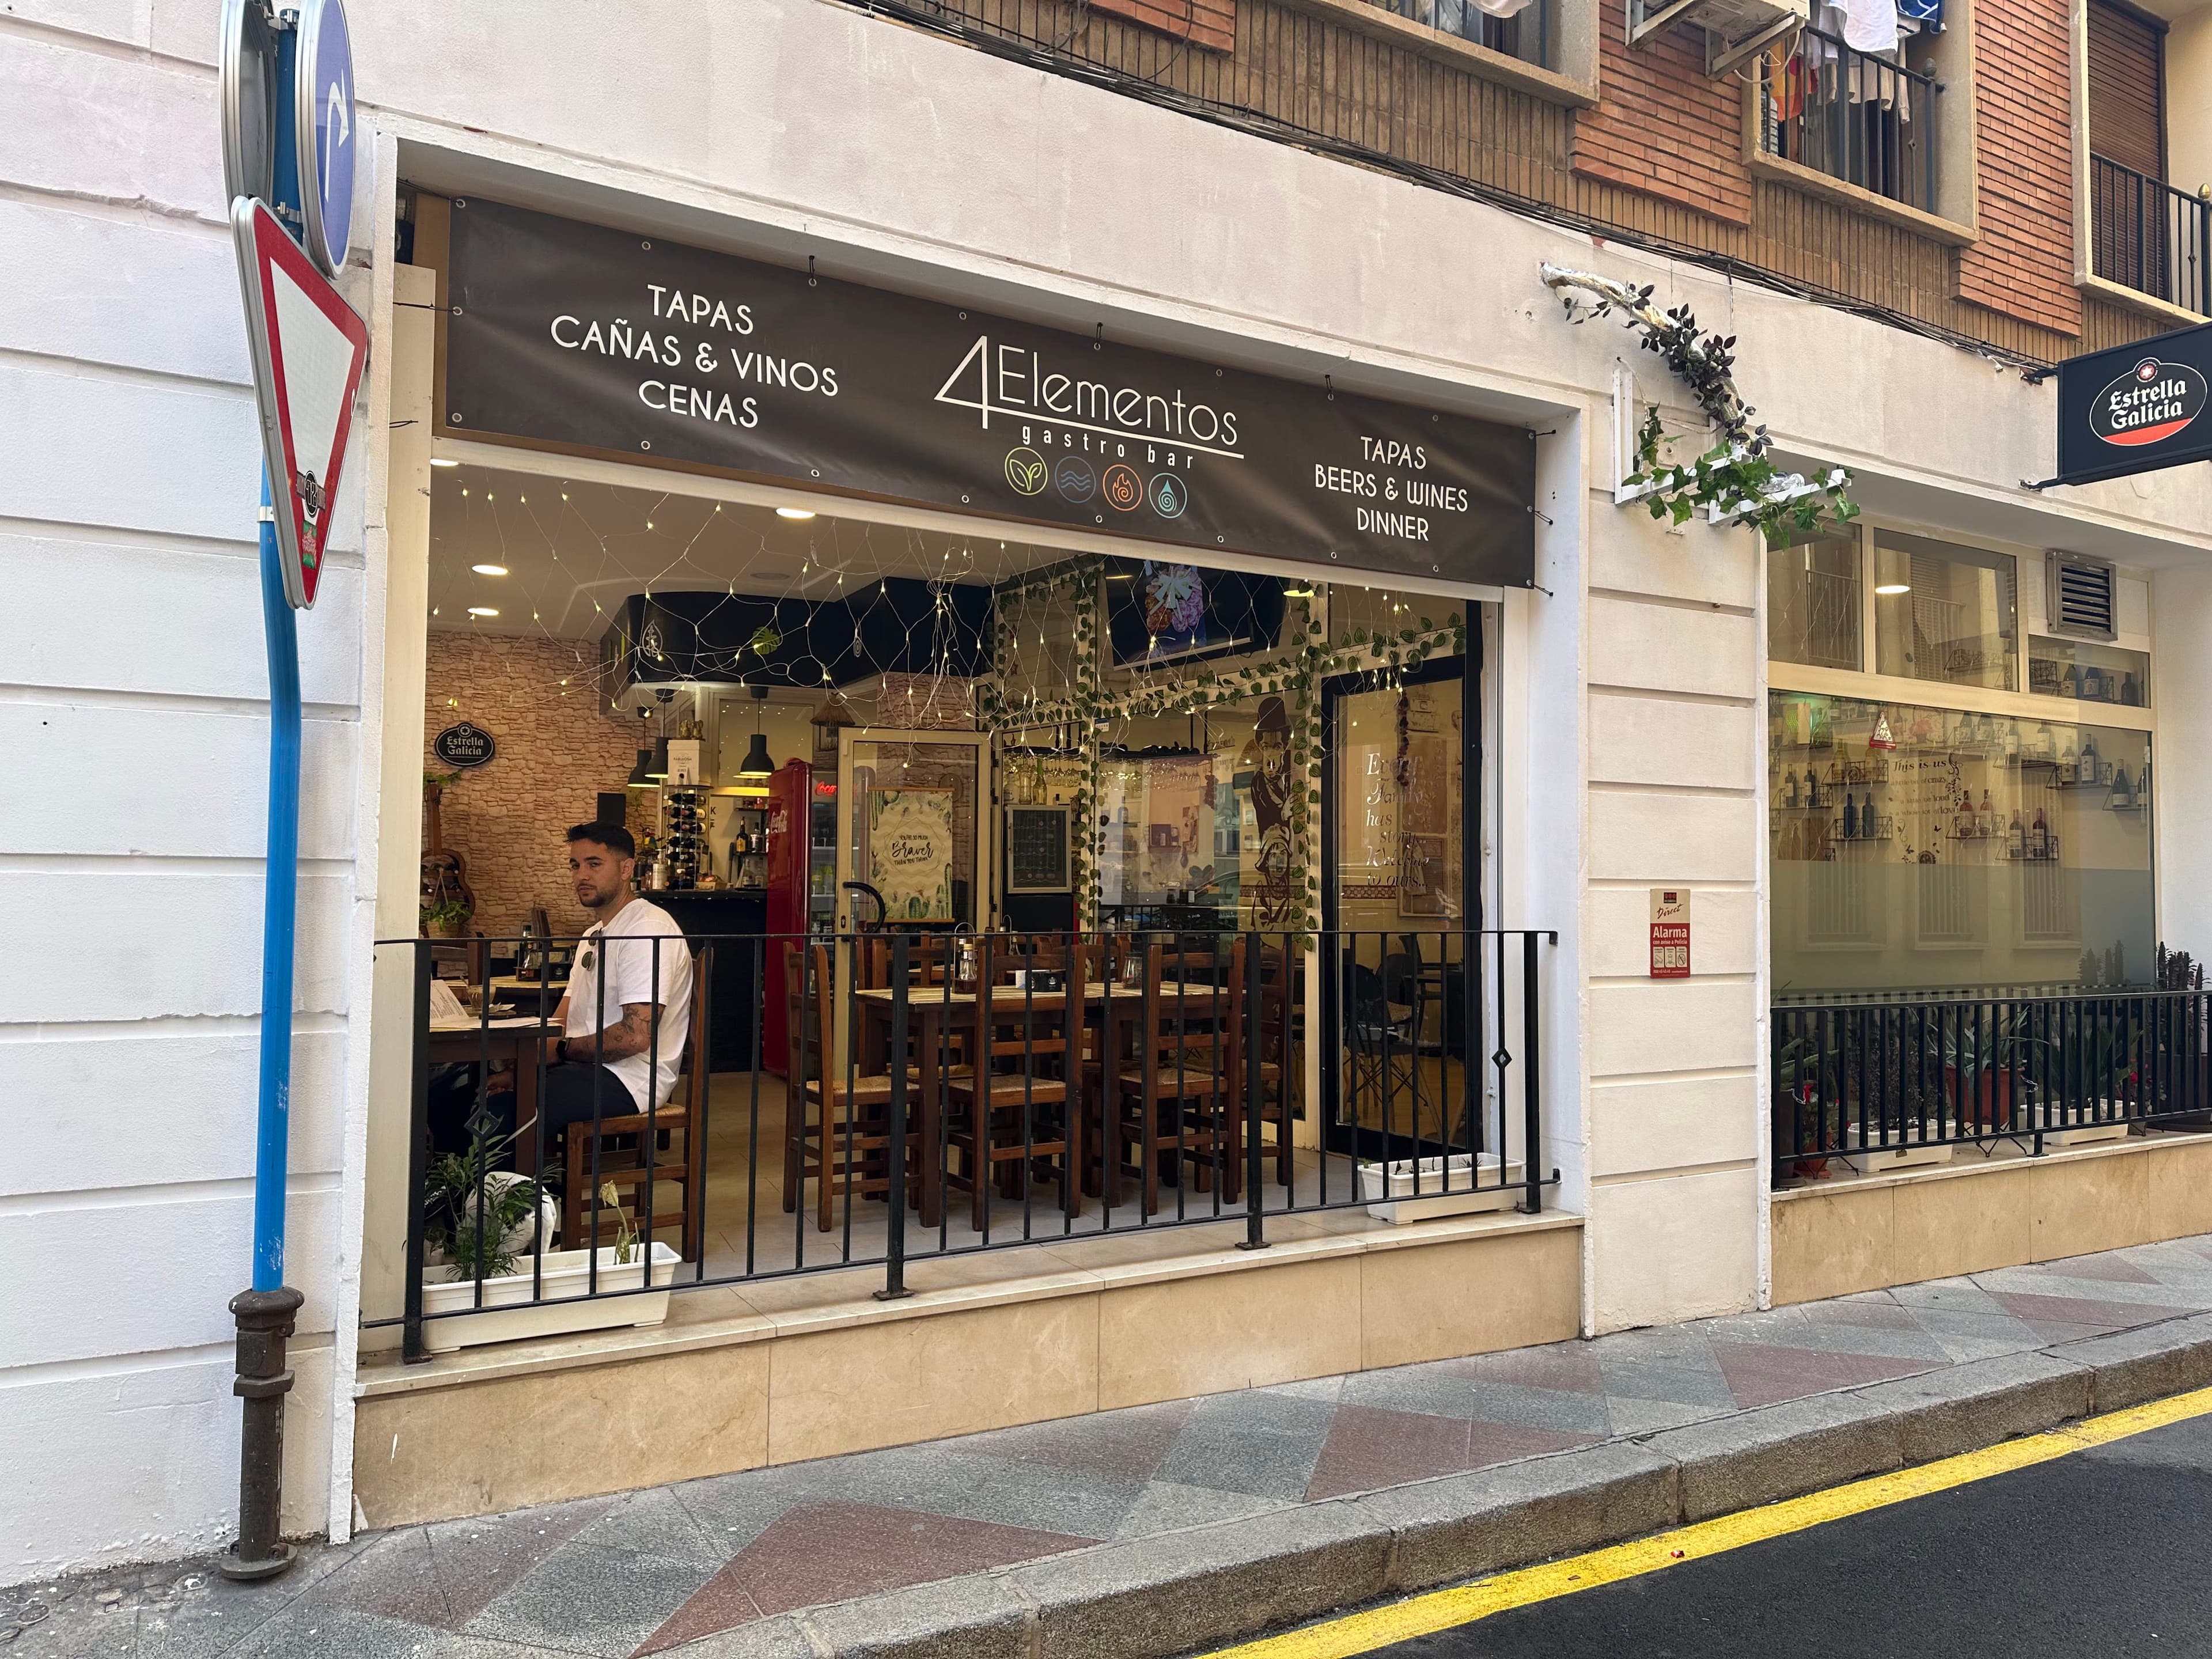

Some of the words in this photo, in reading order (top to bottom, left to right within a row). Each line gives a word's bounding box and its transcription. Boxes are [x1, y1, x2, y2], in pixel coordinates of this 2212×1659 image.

[647, 284, 753, 335] TAPAS
[551, 315, 681, 366] CAÑAS
[695, 342, 718, 372] &
[731, 349, 839, 396] VINOS
[638, 380, 758, 428] CENAS
[2108, 378, 2187, 411] Estrella
[2111, 399, 2183, 429] Galicia
[1022, 425, 1125, 458] gastro
[1147, 444, 1194, 469] bar
[1361, 436, 1426, 469] TAPAS
[1315, 464, 1377, 497] BEERS
[1385, 477, 1399, 501] &
[1407, 480, 1468, 512] WINES
[1357, 507, 1429, 541] DINNER
[446, 736, 484, 746] Estrella
[448, 745, 482, 755] Galicia
[1919, 759, 1929, 769] is
[1933, 760, 1946, 768] us
[892, 840, 934, 858] Braver
[1657, 903, 1684, 919] Direct
[1653, 926, 1688, 938] Alarma
